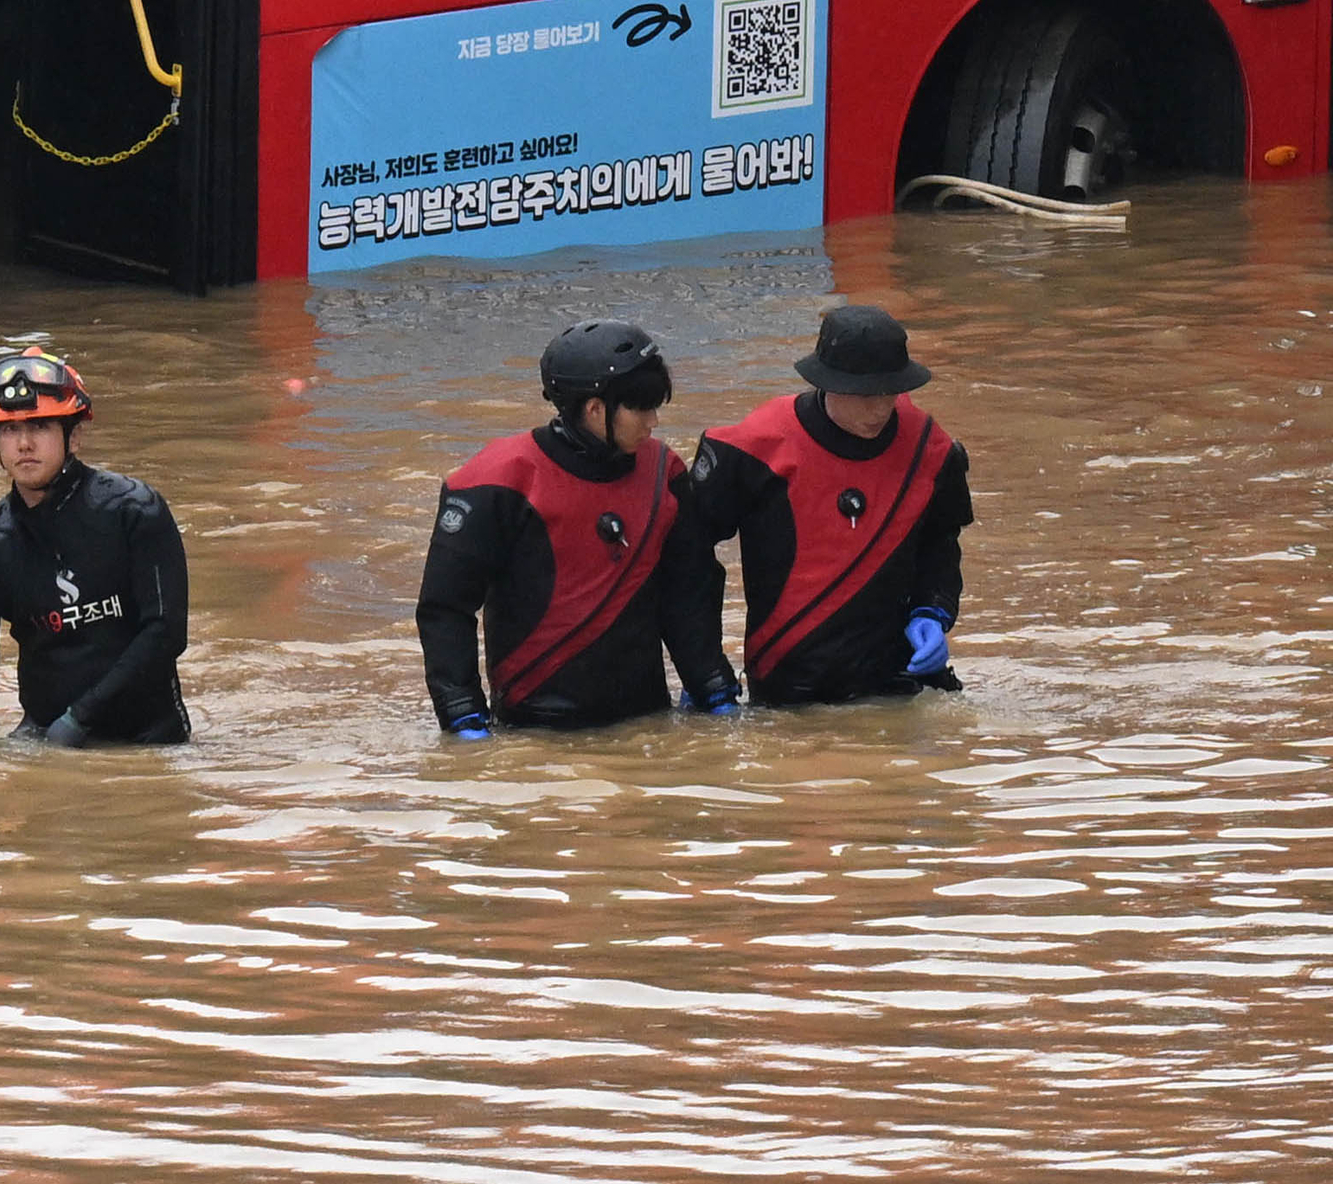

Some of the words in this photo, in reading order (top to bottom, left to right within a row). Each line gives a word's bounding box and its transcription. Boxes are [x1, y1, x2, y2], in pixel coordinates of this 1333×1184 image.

[457, 35, 491, 60] 지금
[496, 31, 529, 55] 당장
[533, 20, 600, 51] 물어보기
[321, 159, 380, 188] 사장님,
[385, 151, 438, 181] 저희도
[444, 140, 515, 172] 훈련하고
[519, 132, 578, 159] 싶어요!
[317, 149, 692, 249] 능력개발전담주치의에게
[701, 133, 815, 195] 물어봐!
